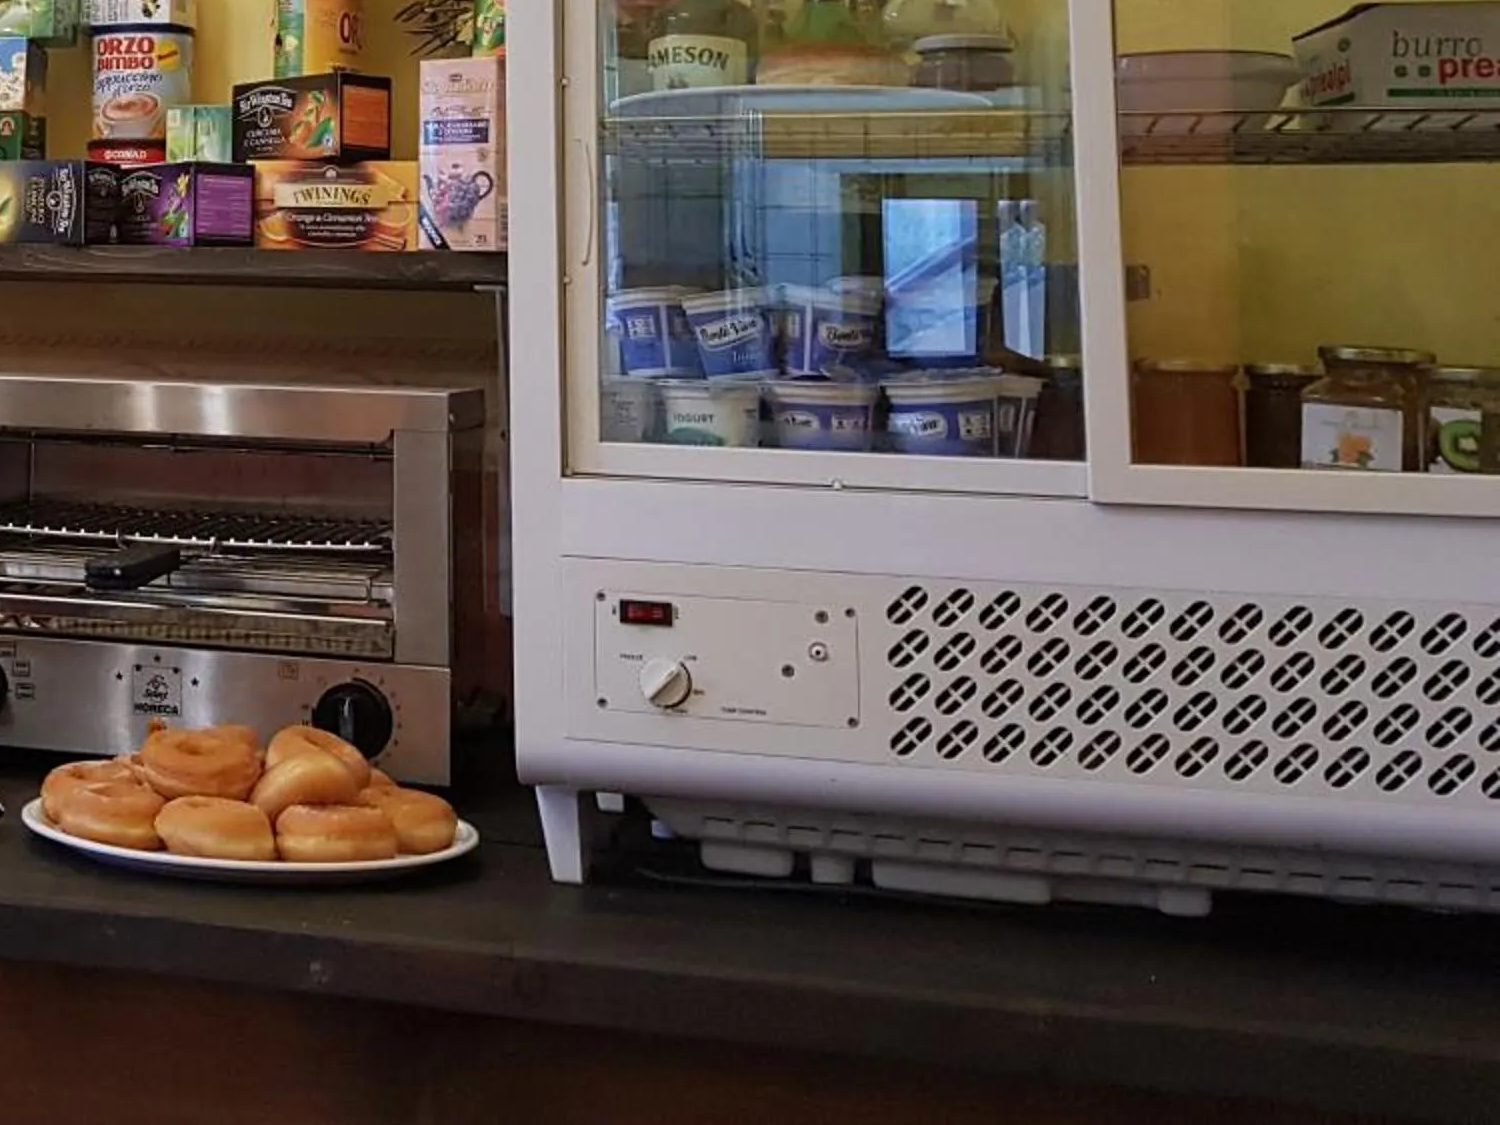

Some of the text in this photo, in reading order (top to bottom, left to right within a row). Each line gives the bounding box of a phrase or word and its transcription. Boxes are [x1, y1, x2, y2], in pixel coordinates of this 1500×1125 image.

[98, 37, 154, 55] ORZO
[1392, 29, 1482, 58] burro
[646, 46, 729, 71] AMESON
[1438, 57, 1500, 86] pre
[110, 150, 147, 159] CONAD
[293, 186, 373, 205] TWININGS
[133, 704, 178, 715] HORECA
